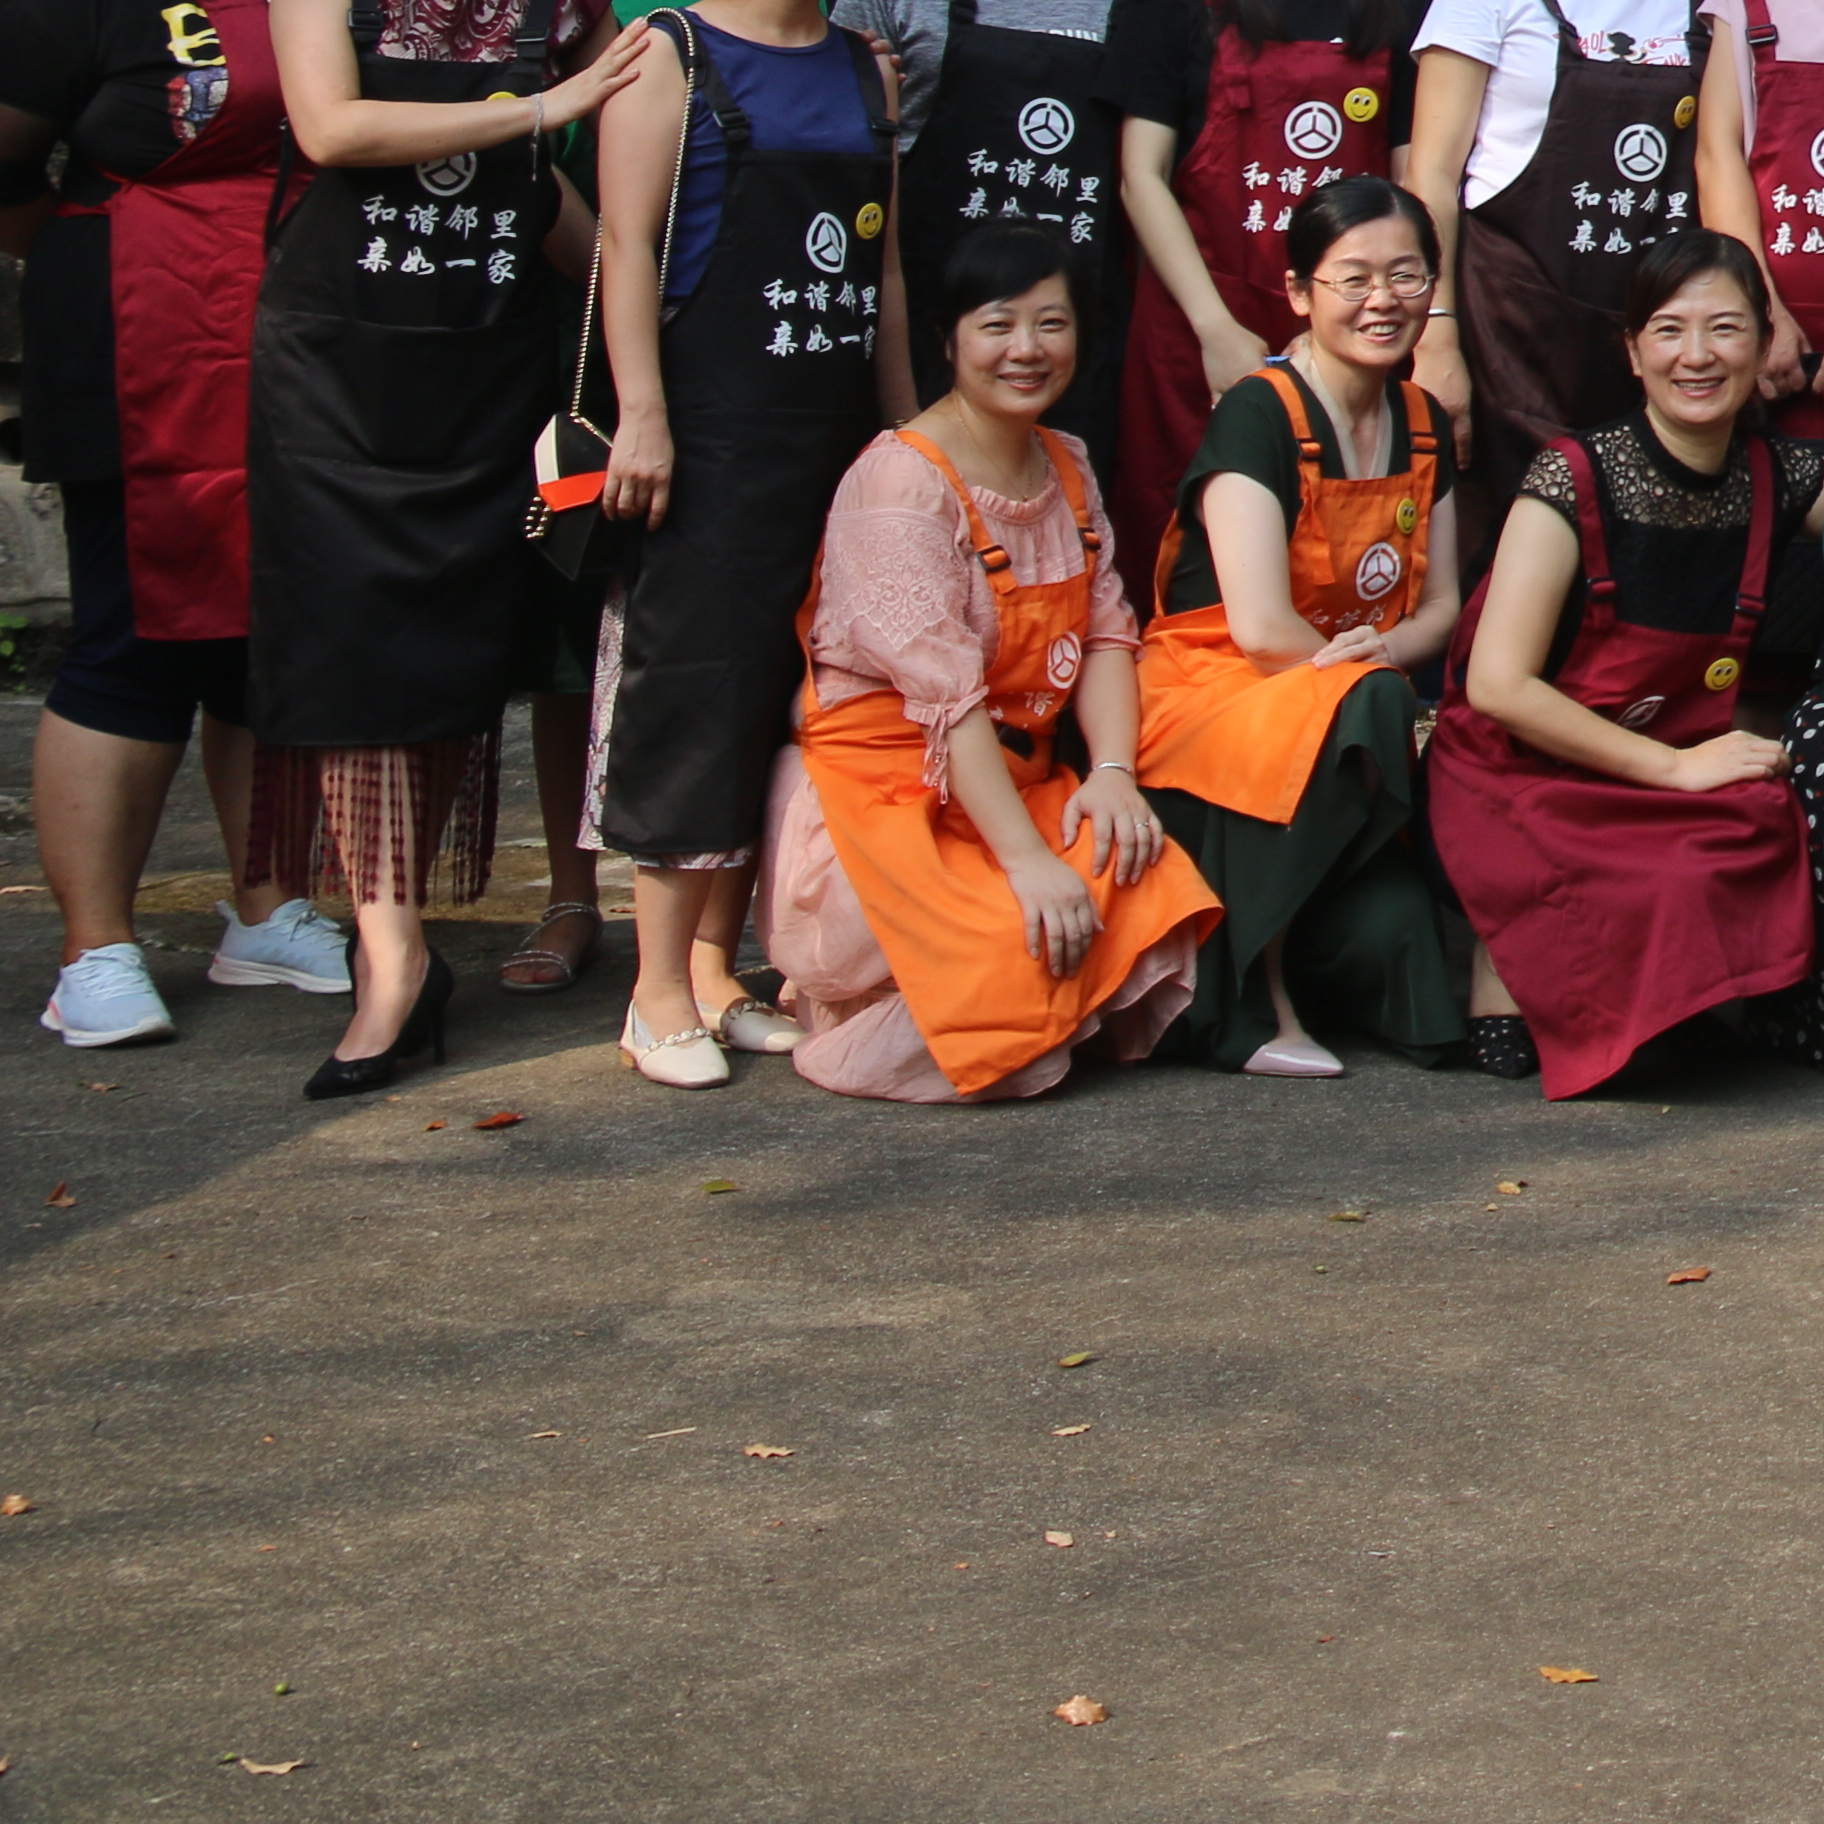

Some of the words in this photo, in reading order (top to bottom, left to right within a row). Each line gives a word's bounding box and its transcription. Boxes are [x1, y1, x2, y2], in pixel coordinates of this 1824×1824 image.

[966, 148, 1101, 204] 和谐邻里
[361, 194, 518, 241] 和谐邻里
[1567, 219, 1679, 254] 亲如一
[356, 236, 516, 284] 亲如一家
[762, 278, 878, 316] 和谐邻里
[765, 320, 876, 360] 亲如一家
